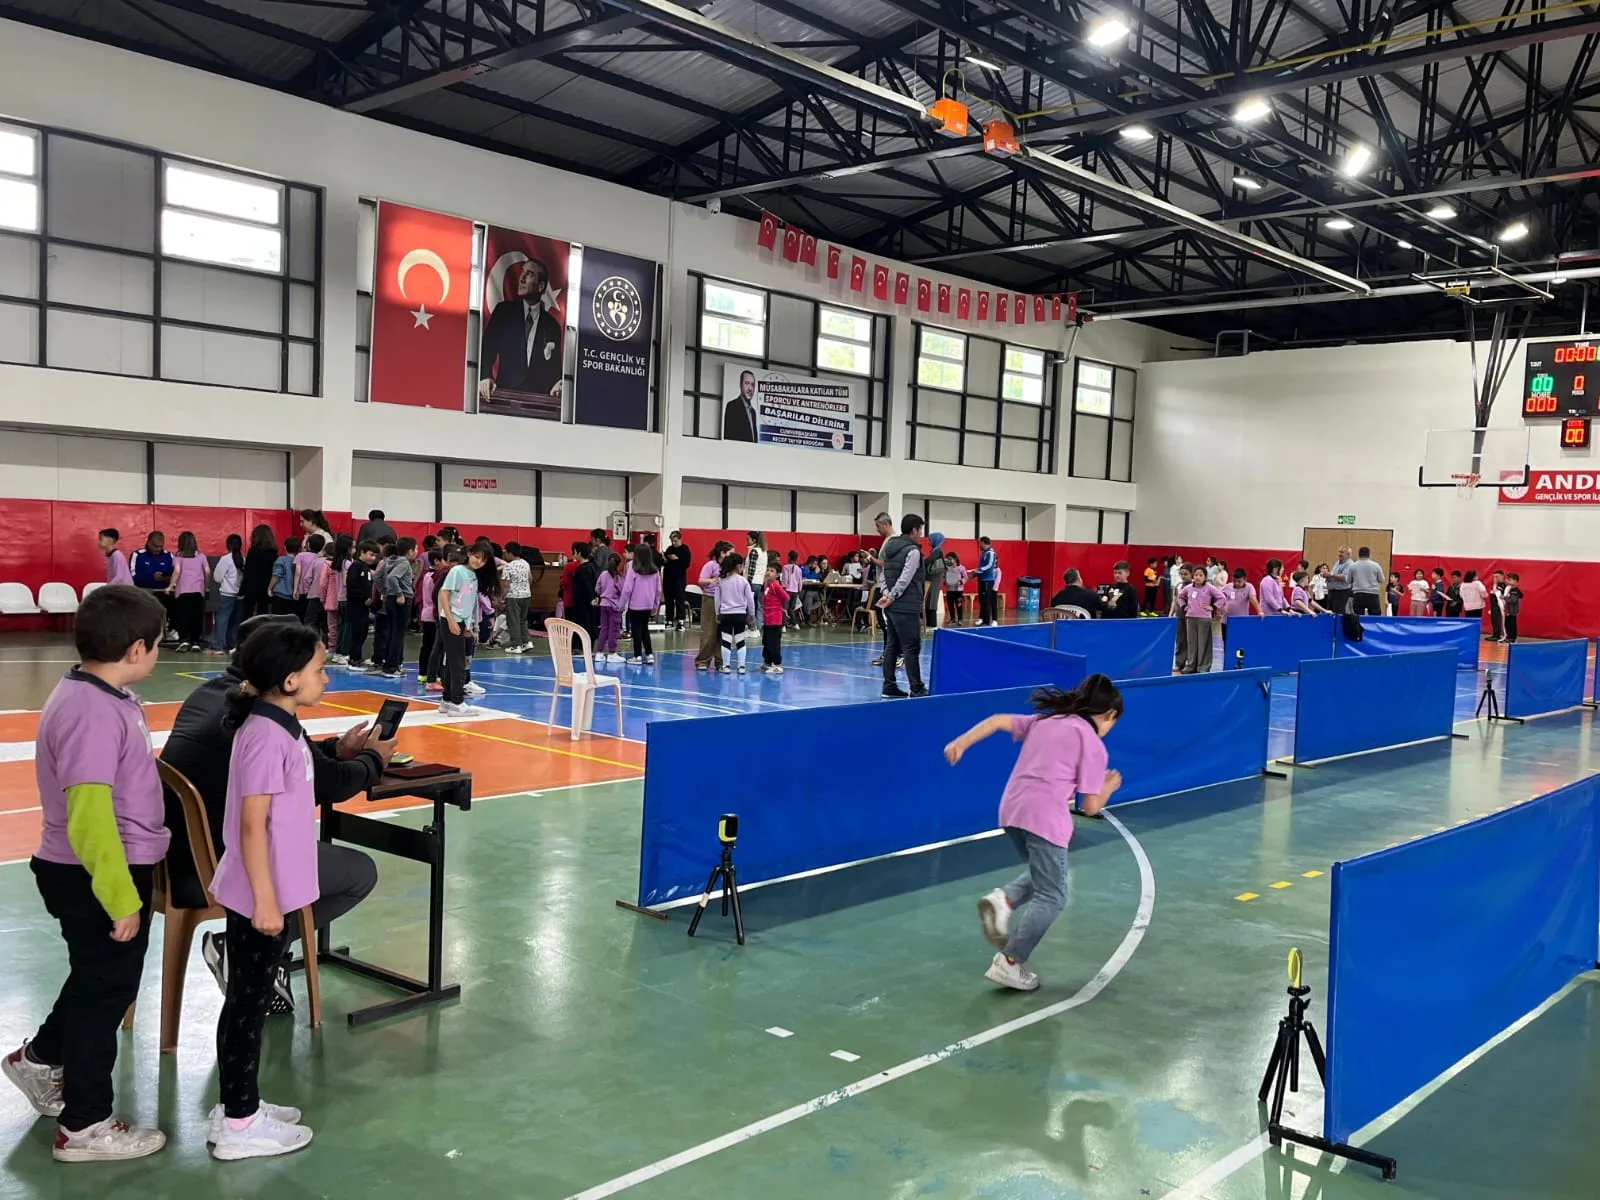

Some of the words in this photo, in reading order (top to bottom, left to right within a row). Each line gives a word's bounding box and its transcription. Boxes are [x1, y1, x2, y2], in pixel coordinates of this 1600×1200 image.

[583, 348, 598, 358] T.C.
[600, 351, 633, 364] GENÇLİK
[636, 357, 646, 365] VE
[582, 360, 603, 370] SPOR
[605, 363, 645, 376] BAKANLIĞI
[810, 387, 834, 396] KATILAN
[1532, 376, 1554, 392] 00
[765, 395, 791, 405] SPORCU
[764, 407, 811, 423] BAŞARILAR
[1535, 492, 1563, 502] GENÇLİK
[1573, 493, 1591, 501] SPOR
